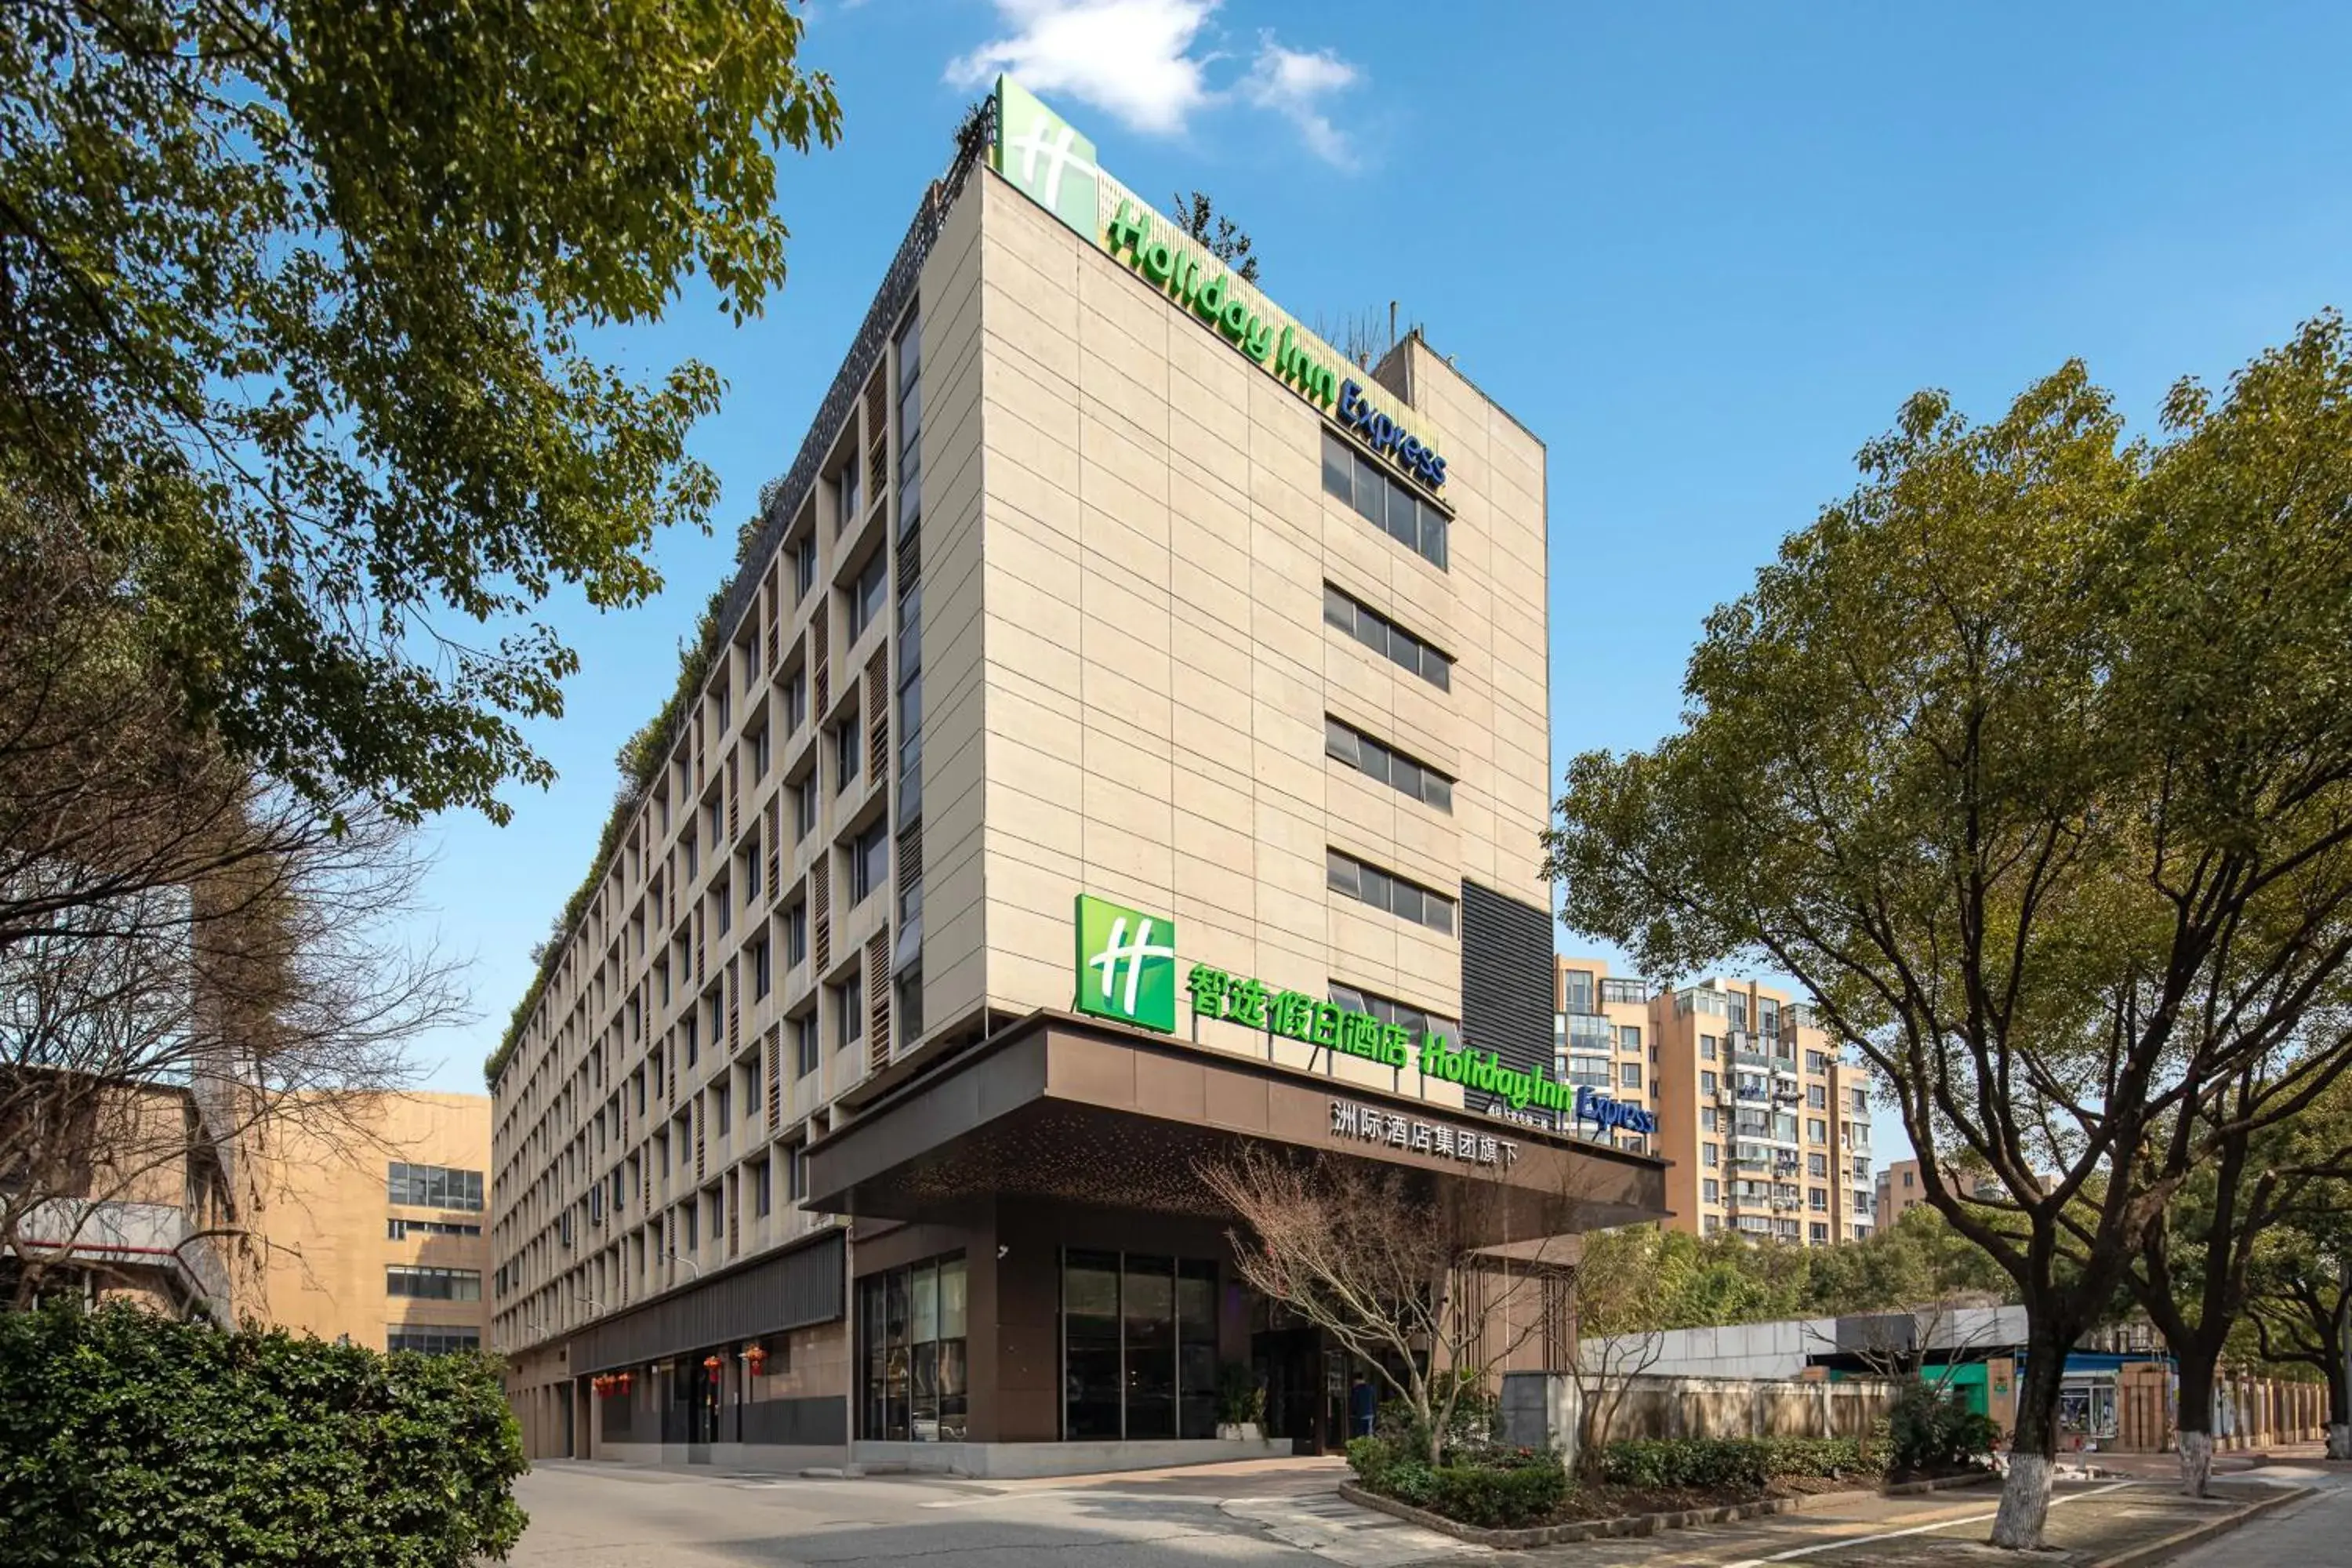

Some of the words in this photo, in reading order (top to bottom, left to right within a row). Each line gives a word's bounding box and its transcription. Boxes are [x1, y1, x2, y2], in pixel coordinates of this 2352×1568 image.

[1108, 198, 1274, 364] Holiday
[1276, 324, 1338, 409] Inn
[1336, 377, 1448, 488] Express
[1186, 963, 1409, 1069] 智选假日酒店
[1332, 1100, 1519, 1167] 洲际酒店集团旗下
[1419, 1031, 1530, 1110] Holiday
[1530, 1064, 1572, 1112] Inn
[1577, 1086, 1656, 1134] Express
